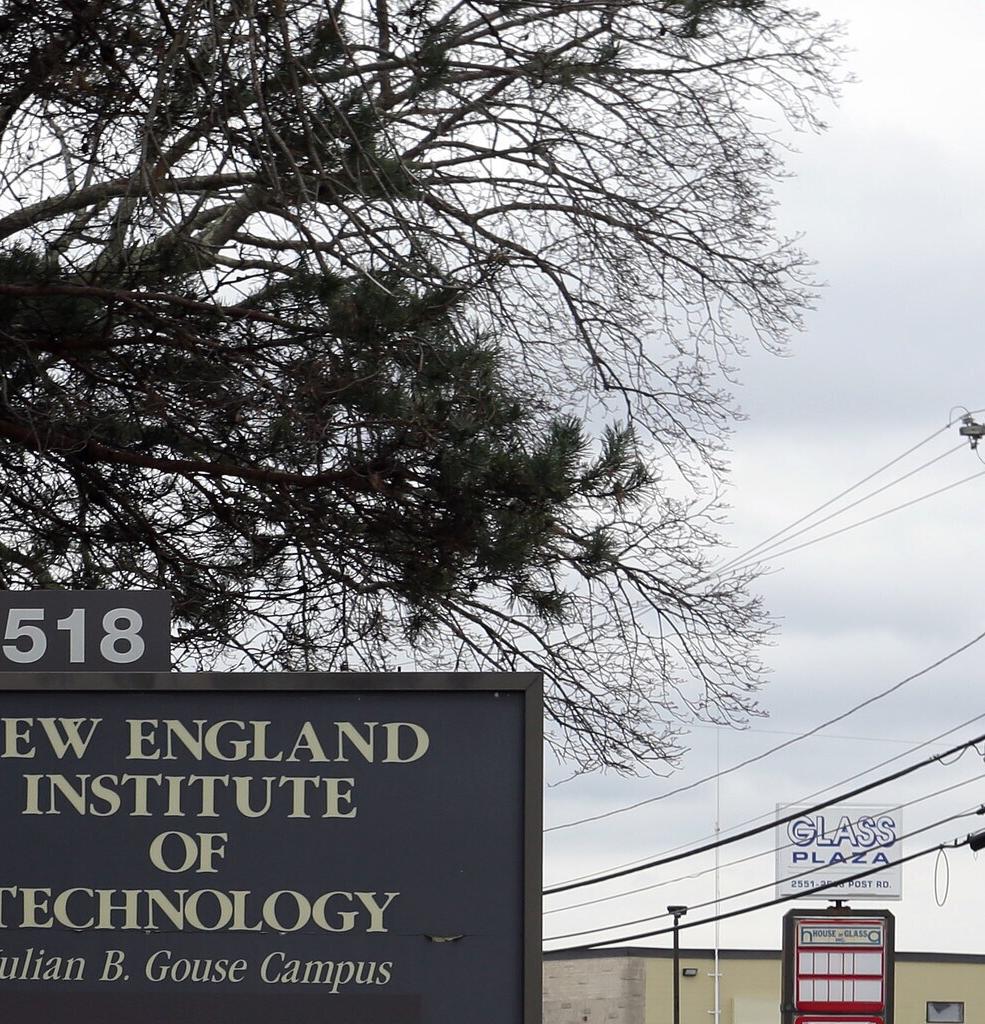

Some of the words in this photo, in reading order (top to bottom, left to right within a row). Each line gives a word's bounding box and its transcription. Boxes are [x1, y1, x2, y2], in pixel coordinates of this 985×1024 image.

[125, 719, 430, 763] ENGLAND
[21, 773, 358, 818] INSTITUTE
[149, 831, 228, 873] OF
[787, 815, 896, 847] GLASS
[792, 851, 890, 865] PLAZA
[812, 930, 836, 938] HOUSE
[843, 930, 869, 938] GLASS
[98, 949, 131, 982] B.
[145, 949, 248, 983] Gouse
[260, 951, 394, 994] Campus
